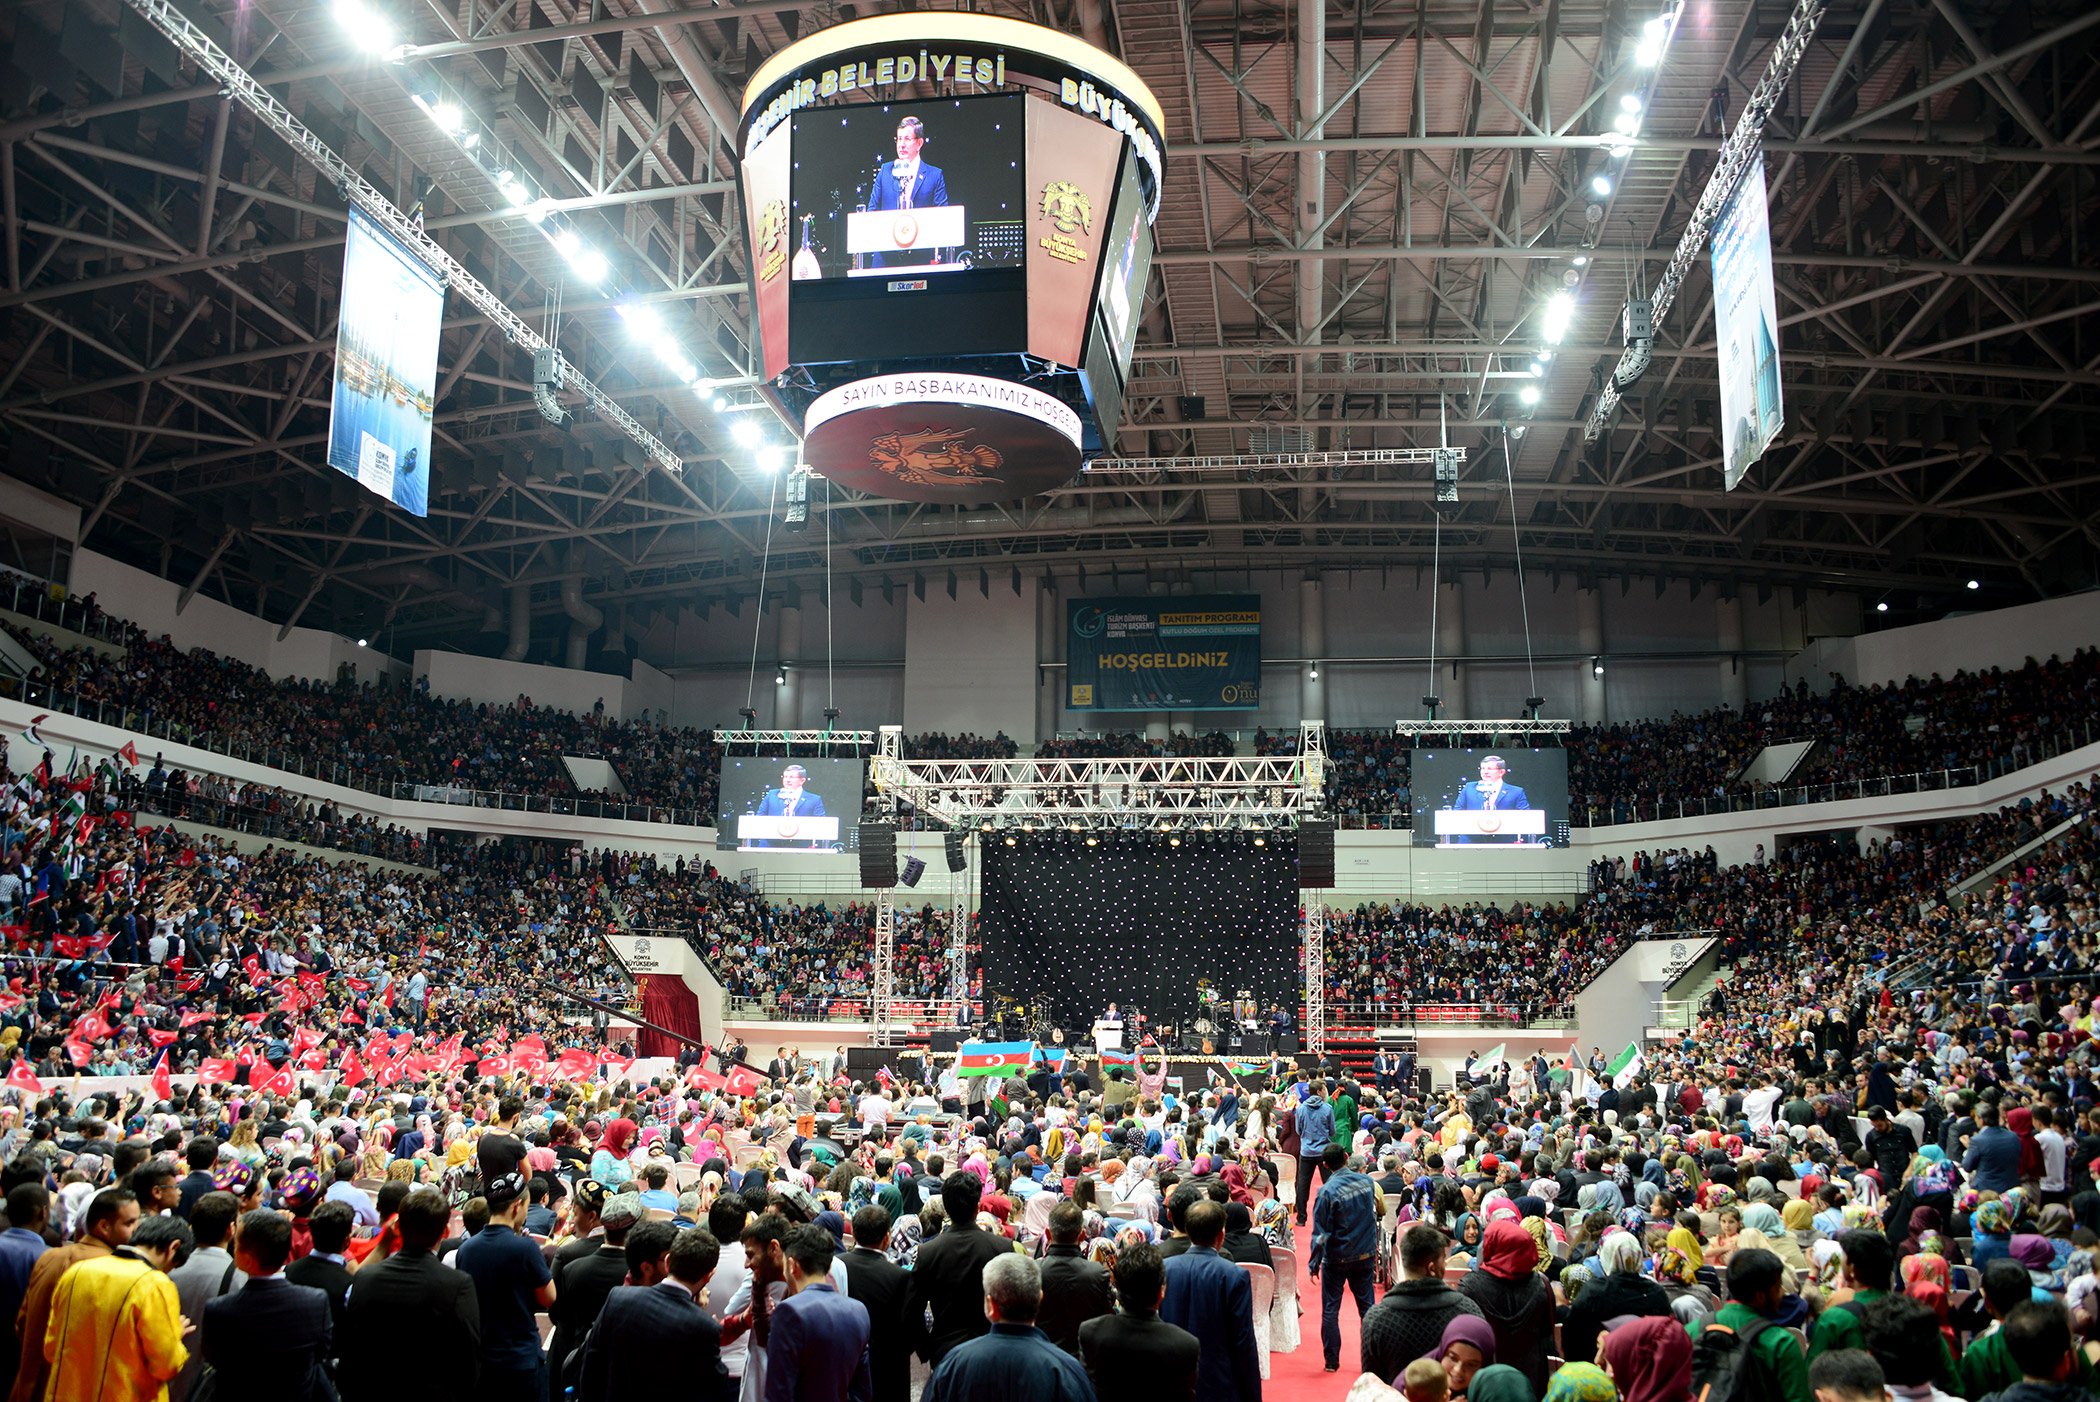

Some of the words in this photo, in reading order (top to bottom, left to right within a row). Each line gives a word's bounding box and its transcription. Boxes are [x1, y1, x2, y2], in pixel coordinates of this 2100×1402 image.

[821, 49, 1005, 98] BELEDİYESİ
[1052, 233, 1077, 247] KONYA
[843, 382, 888, 406] SAYIN
[894, 379, 1029, 408] BAŞBAKANIMIZ
[1163, 615, 1202, 624] TANITIM
[1205, 613, 1257, 622] PROGRAMI
